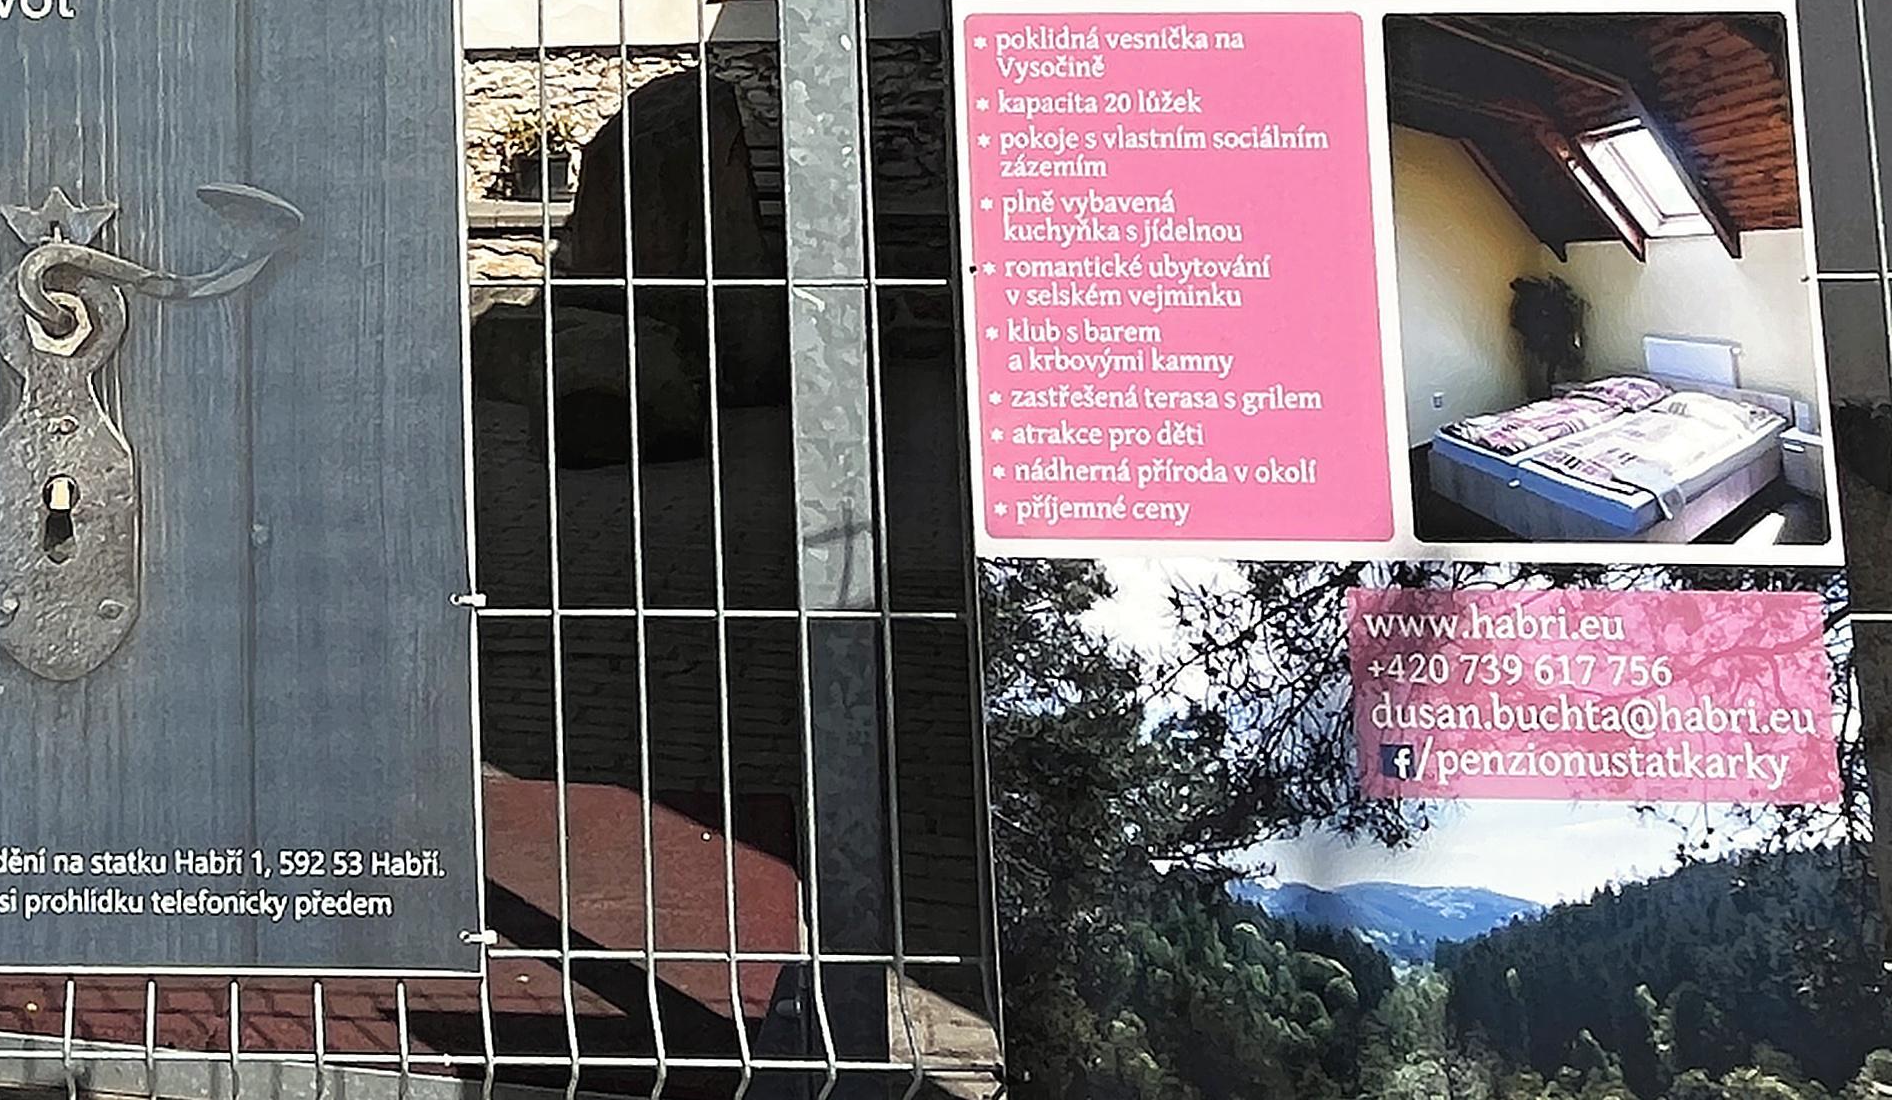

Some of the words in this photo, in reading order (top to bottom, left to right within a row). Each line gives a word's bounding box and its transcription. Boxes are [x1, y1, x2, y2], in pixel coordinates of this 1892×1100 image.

[996, 26, 1100, 54] poklidná
[1106, 24, 1209, 49] vesnička
[1215, 31, 1244, 49] na
[997, 55, 1105, 84] Vysočině
[997, 90, 1098, 119] kapacita
[1104, 94, 1132, 113] 20
[1138, 89, 1202, 113] lůžek
[999, 126, 1081, 156] pokoje
[1085, 133, 1096, 149] s
[1103, 125, 1206, 149] vlastním
[1212, 124, 1328, 149] sociálním
[1000, 154, 1107, 178] zázemím
[1003, 190, 1054, 218] plně
[1061, 189, 1175, 220] vybavená
[1003, 217, 1120, 248] kuchyňka
[1126, 227, 1138, 241] s
[1140, 218, 1243, 247] jídelnou
[1004, 255, 1142, 278] romantické
[1149, 255, 1271, 284] ubytování
[1005, 289, 1020, 306] v
[1026, 282, 1122, 306] selském
[1007, 318, 1061, 343] klub
[1066, 327, 1078, 343] s
[1083, 318, 1162, 343] barem
[1008, 354, 1022, 371] a
[1028, 347, 1144, 378] krbovými
[1150, 347, 1234, 378] kamny
[1010, 385, 1139, 410] zastřešená
[1143, 389, 1218, 409] terasa
[1224, 394, 1236, 409] s
[1240, 385, 1322, 416] grilem
[1012, 421, 1102, 445] atrakce
[1108, 427, 1151, 451] pro
[1156, 421, 1205, 445] děti
[1014, 458, 1131, 482] nádherná
[1137, 457, 1228, 488] příroda
[1235, 466, 1249, 483] v
[1254, 459, 1317, 484] okolí
[1016, 495, 1127, 525] příjemné
[1132, 501, 1191, 526] ceny
[1363, 604, 1625, 641] www.habri.eu
[1366, 654, 1449, 685] +420
[1462, 654, 1523, 685] 739
[1534, 654, 1596, 686] 617
[1608, 655, 1672, 687] 756
[1371, 694, 1817, 738] dusan.buchta@habri.eu
[53, 854, 84, 874] na
[91, 848, 167, 875] statku
[175, 849, 242, 875] Habří
[251, 851, 272, 879] 1,
[280, 851, 325, 876] 592
[333, 851, 362, 876] 53
[371, 851, 446, 876] Habří.
[24, 888, 144, 919] prohlídku
[150, 890, 286, 922] telefonicky
[295, 892, 393, 921] předem
